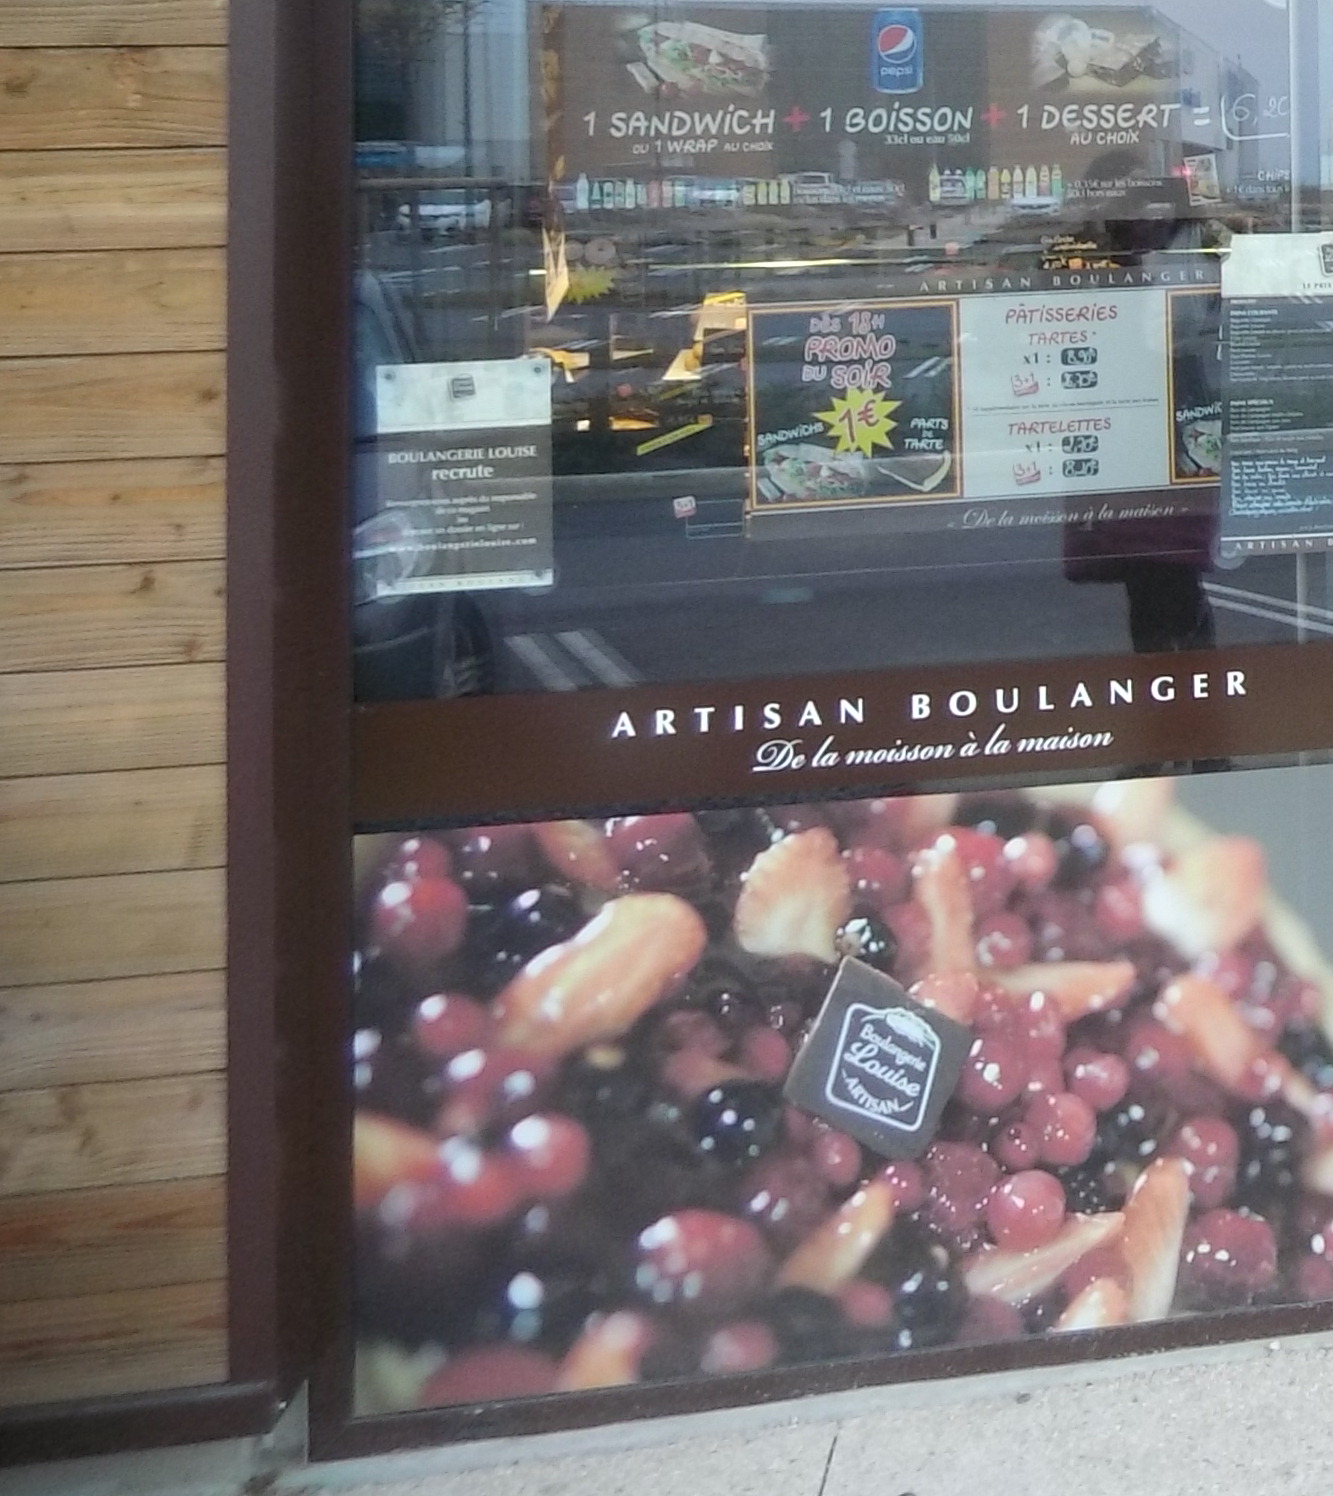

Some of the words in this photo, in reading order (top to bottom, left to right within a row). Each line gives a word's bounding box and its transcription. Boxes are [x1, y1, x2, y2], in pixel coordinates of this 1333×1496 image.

[880, 65, 913, 78] pepsi
[1041, 104, 1181, 129] DESSERT
[667, 138, 718, 154] WRAP
[1070, 132, 1092, 145] AU
[919, 276, 1032, 292] ARTISAN
[1053, 270, 1204, 287] BOULANGER
[1028, 330, 1087, 345] TARTES
[805, 335, 896, 362] PROMO
[802, 365, 827, 381] DU
[910, 418, 949, 430] PARTS
[1008, 418, 1111, 435] TARTELETTES
[904, 438, 944, 450] TARTE
[388, 447, 485, 464] BOULANGERIE
[488, 445, 537, 459] LOUISE
[431, 464, 494, 480] recrute
[1235, 538, 1313, 550] ARTISAN
[612, 697, 864, 739] ARTISAN
[911, 669, 1247, 720] BOULANGER
[752, 738, 806, 773] De
[810, 732, 842, 768] la
[846, 732, 955, 766] moisson
[959, 728, 979, 758] à
[984, 723, 1012, 757] la
[1016, 727, 1115, 754] maison
[859, 1023, 926, 1071] Boulangerie
[843, 1042, 921, 1097] Louise
[845, 1077, 900, 1114] ARTISAN
